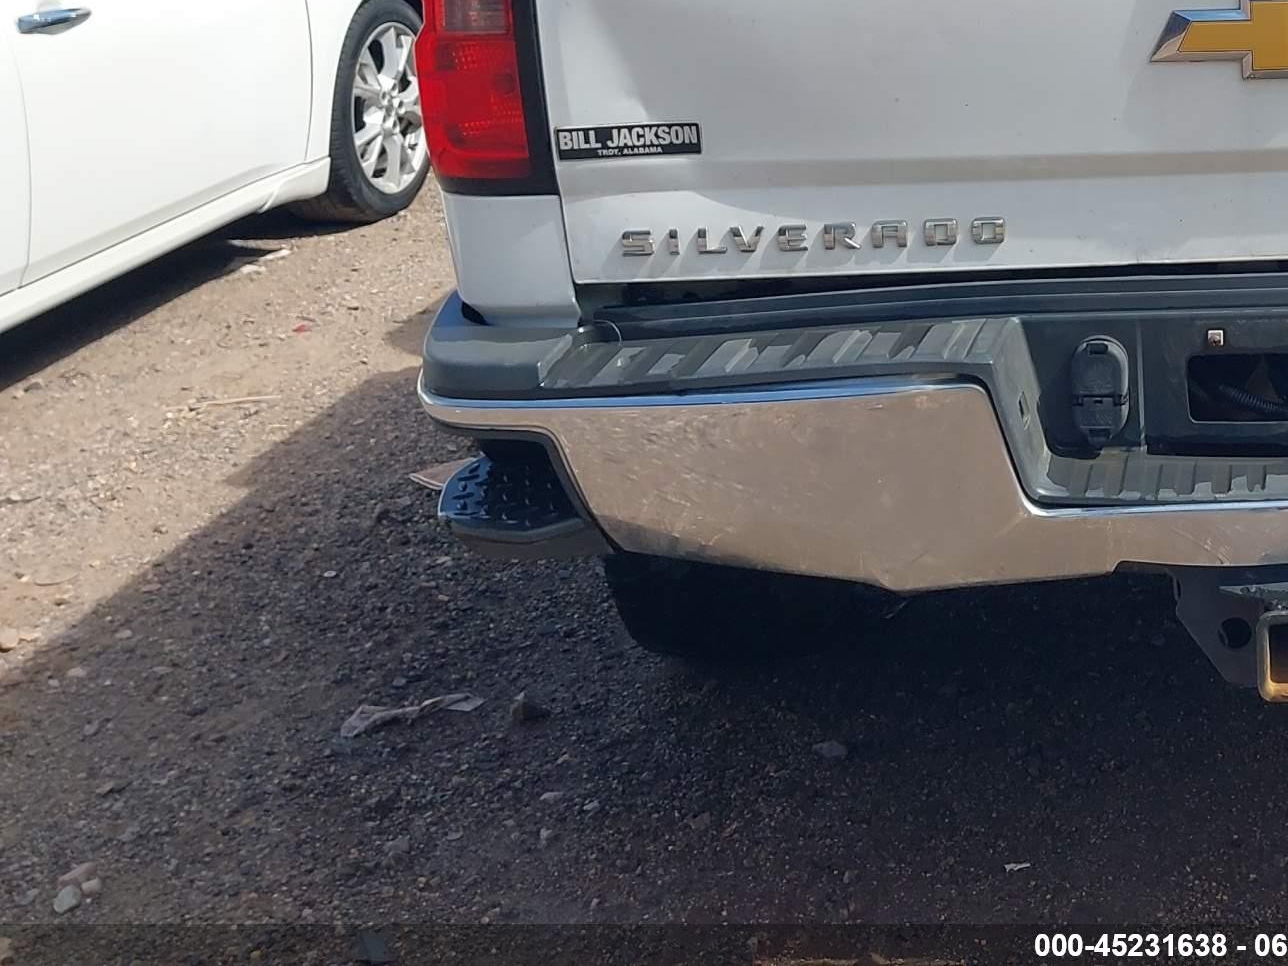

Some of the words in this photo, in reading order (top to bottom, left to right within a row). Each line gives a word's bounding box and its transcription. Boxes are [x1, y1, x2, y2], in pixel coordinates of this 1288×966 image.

[558, 130, 602, 150] BILL
[606, 125, 698, 148] JACKSON
[622, 146, 664, 155] ALABAMA
[621, 216, 1006, 257] SILVERADO
